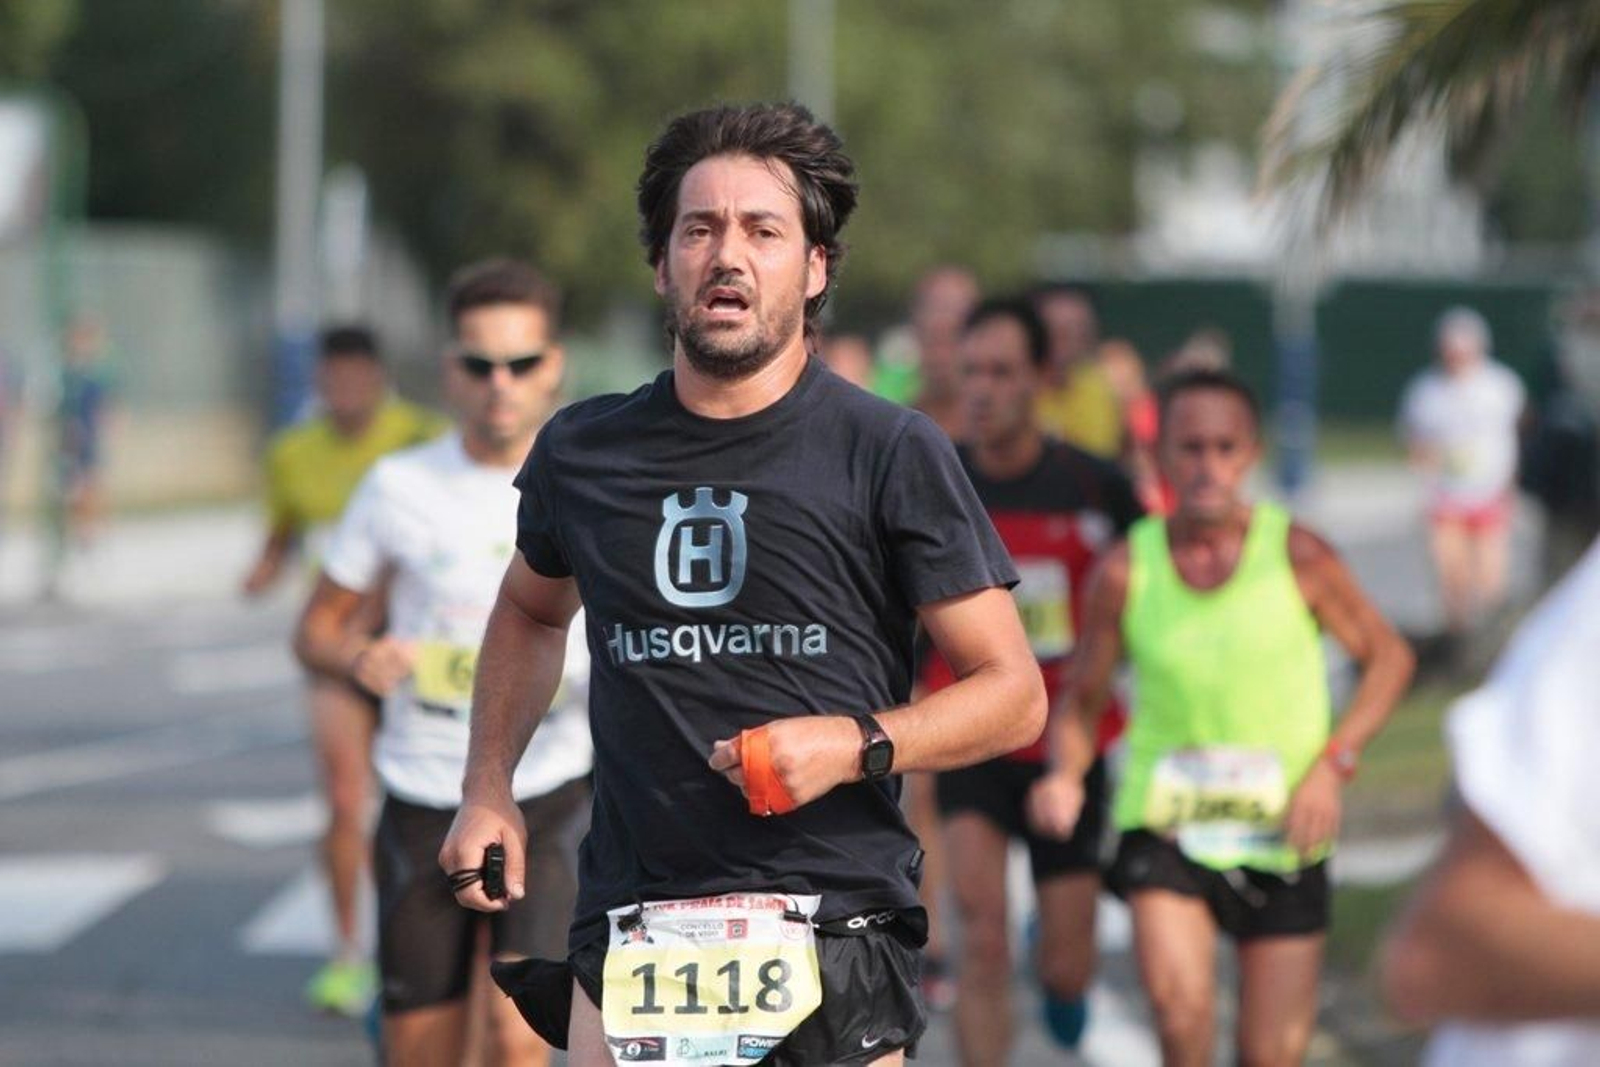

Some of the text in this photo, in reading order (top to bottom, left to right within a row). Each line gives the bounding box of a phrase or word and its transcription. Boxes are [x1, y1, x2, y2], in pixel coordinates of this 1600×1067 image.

[679, 525, 723, 584] H
[603, 622, 828, 664] Husqvarna
[631, 958, 792, 1014] 1118
